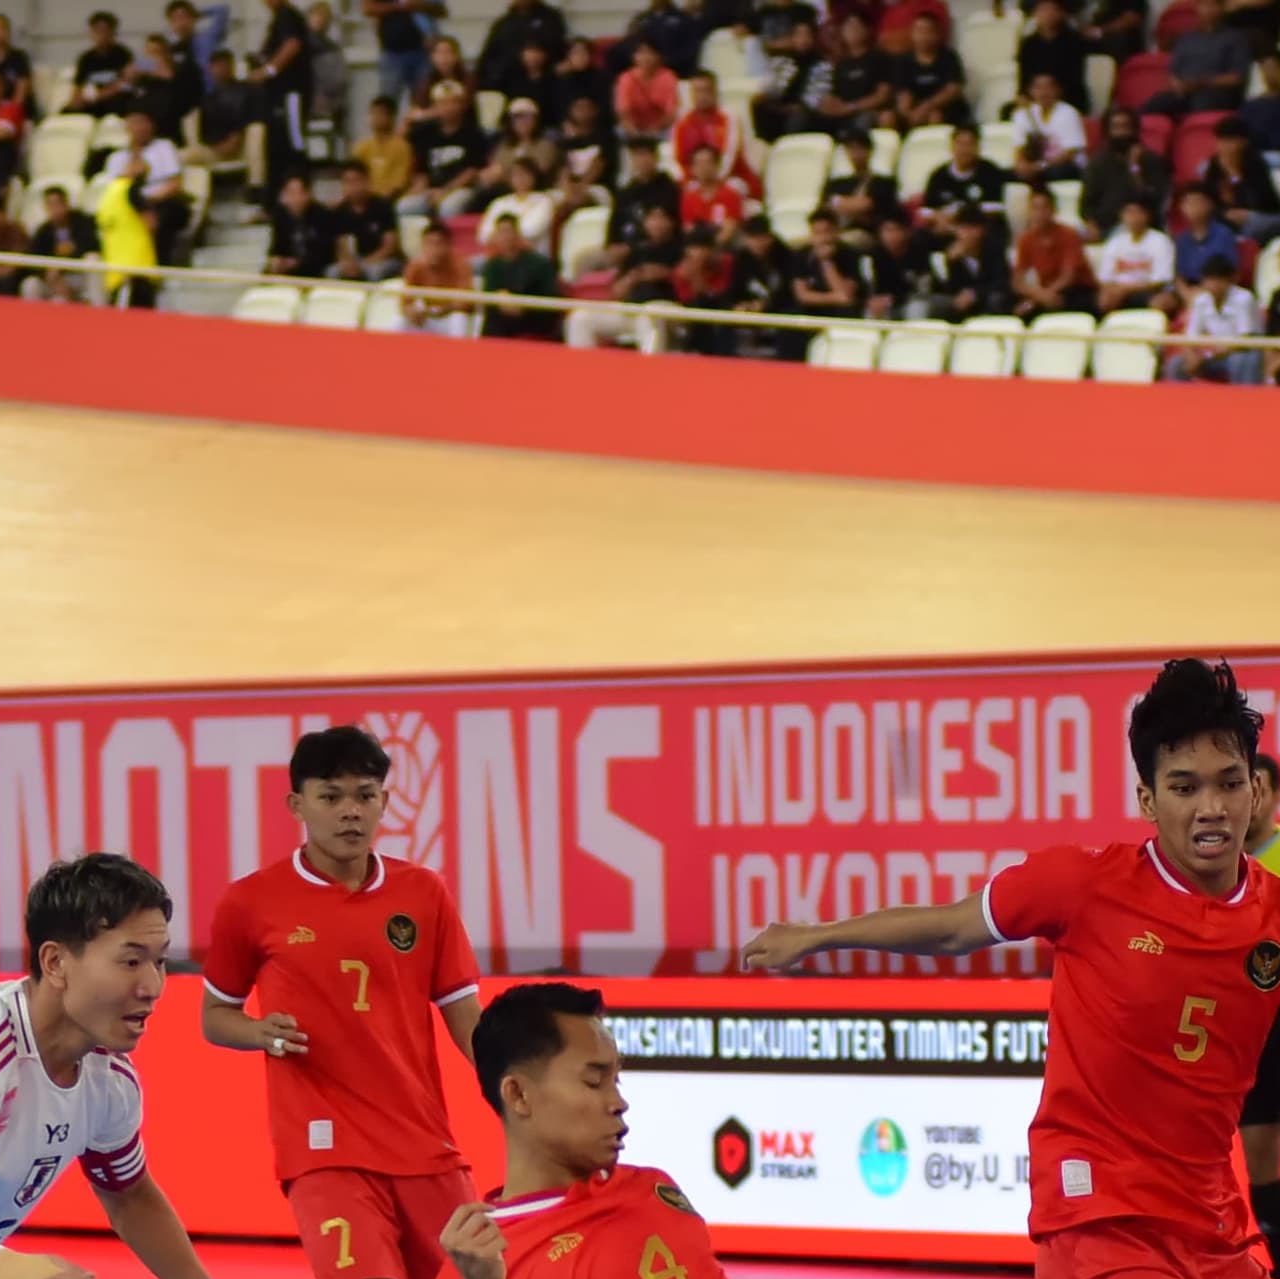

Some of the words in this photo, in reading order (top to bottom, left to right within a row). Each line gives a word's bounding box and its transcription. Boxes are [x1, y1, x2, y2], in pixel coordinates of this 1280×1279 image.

[695, 694, 1091, 827] INDONESIA
[1127, 938, 1164, 956] SPECS
[339, 959, 371, 1012] 7
[718, 1017, 886, 1061] DOKUMENTER
[889, 1019, 988, 1062] TIMNAS
[1173, 995, 1217, 1063] 5
[759, 1131, 815, 1158] MAX
[923, 1126, 983, 1144] YOUTUBE
[760, 1163, 817, 1179] STREAM
[320, 1216, 355, 1269] 7
